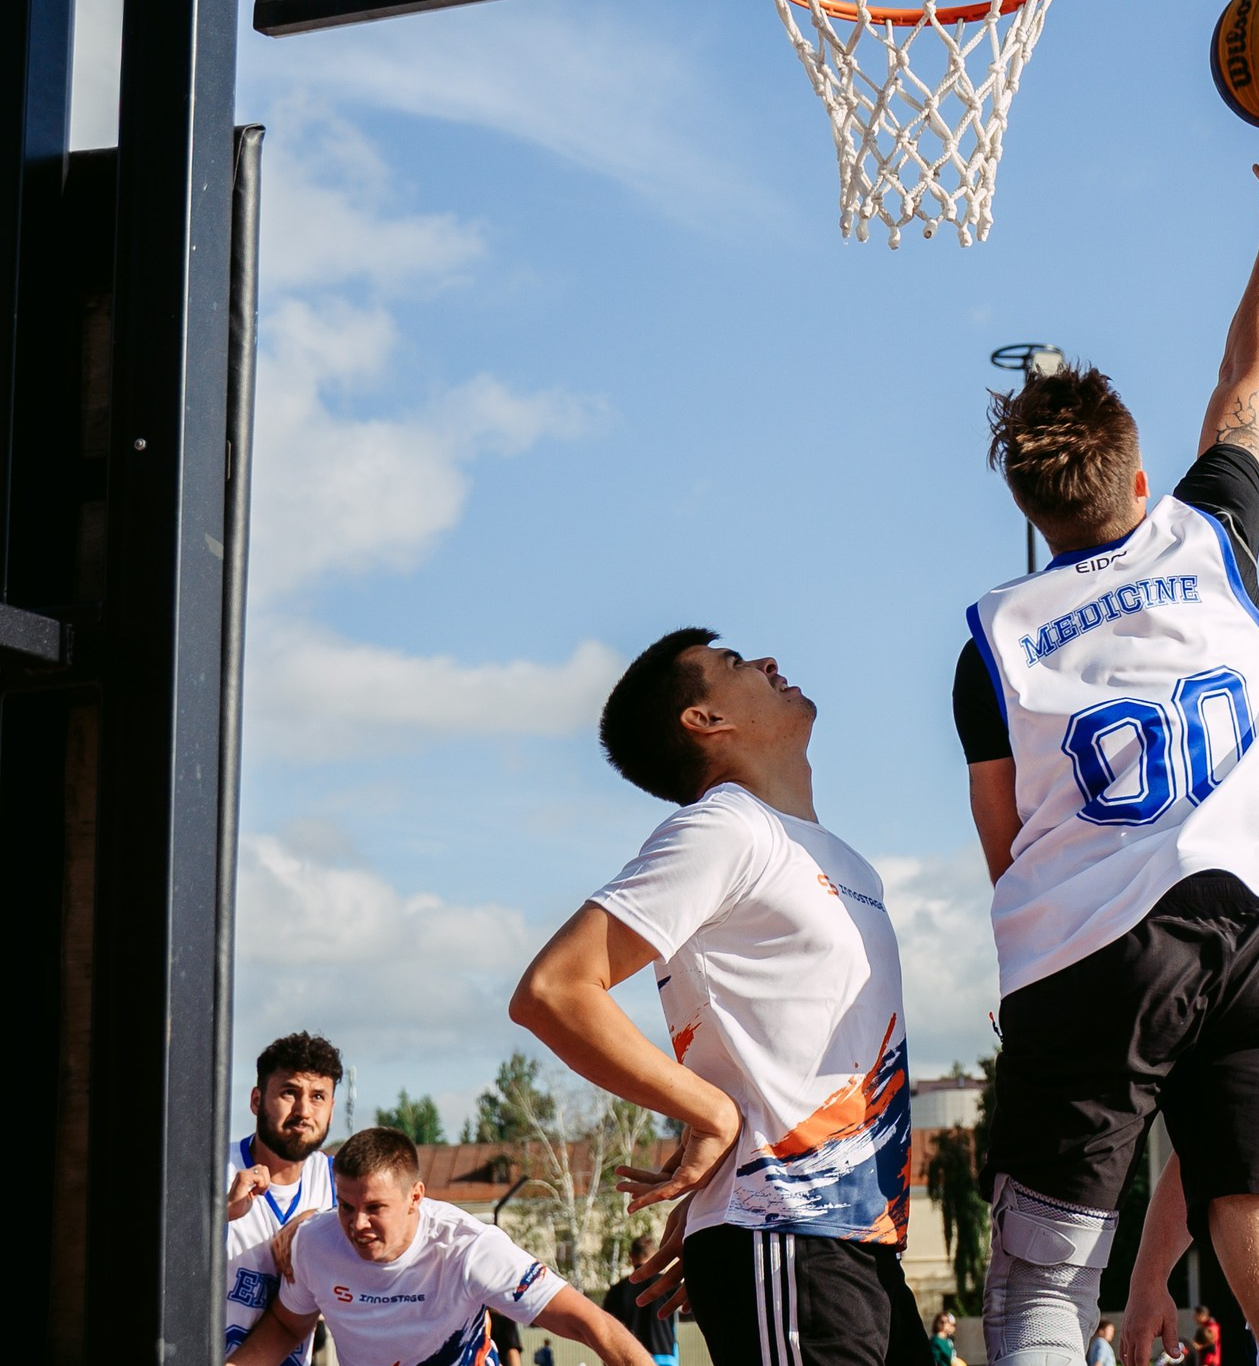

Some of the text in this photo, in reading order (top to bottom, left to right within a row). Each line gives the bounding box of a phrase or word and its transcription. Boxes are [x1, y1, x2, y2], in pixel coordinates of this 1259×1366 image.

[1075, 550, 1127, 573] EID
[1019, 574, 1202, 668] MEDICINE
[1061, 665, 1257, 827] 00
[359, 1293, 426, 1304] INNOSTAGE
